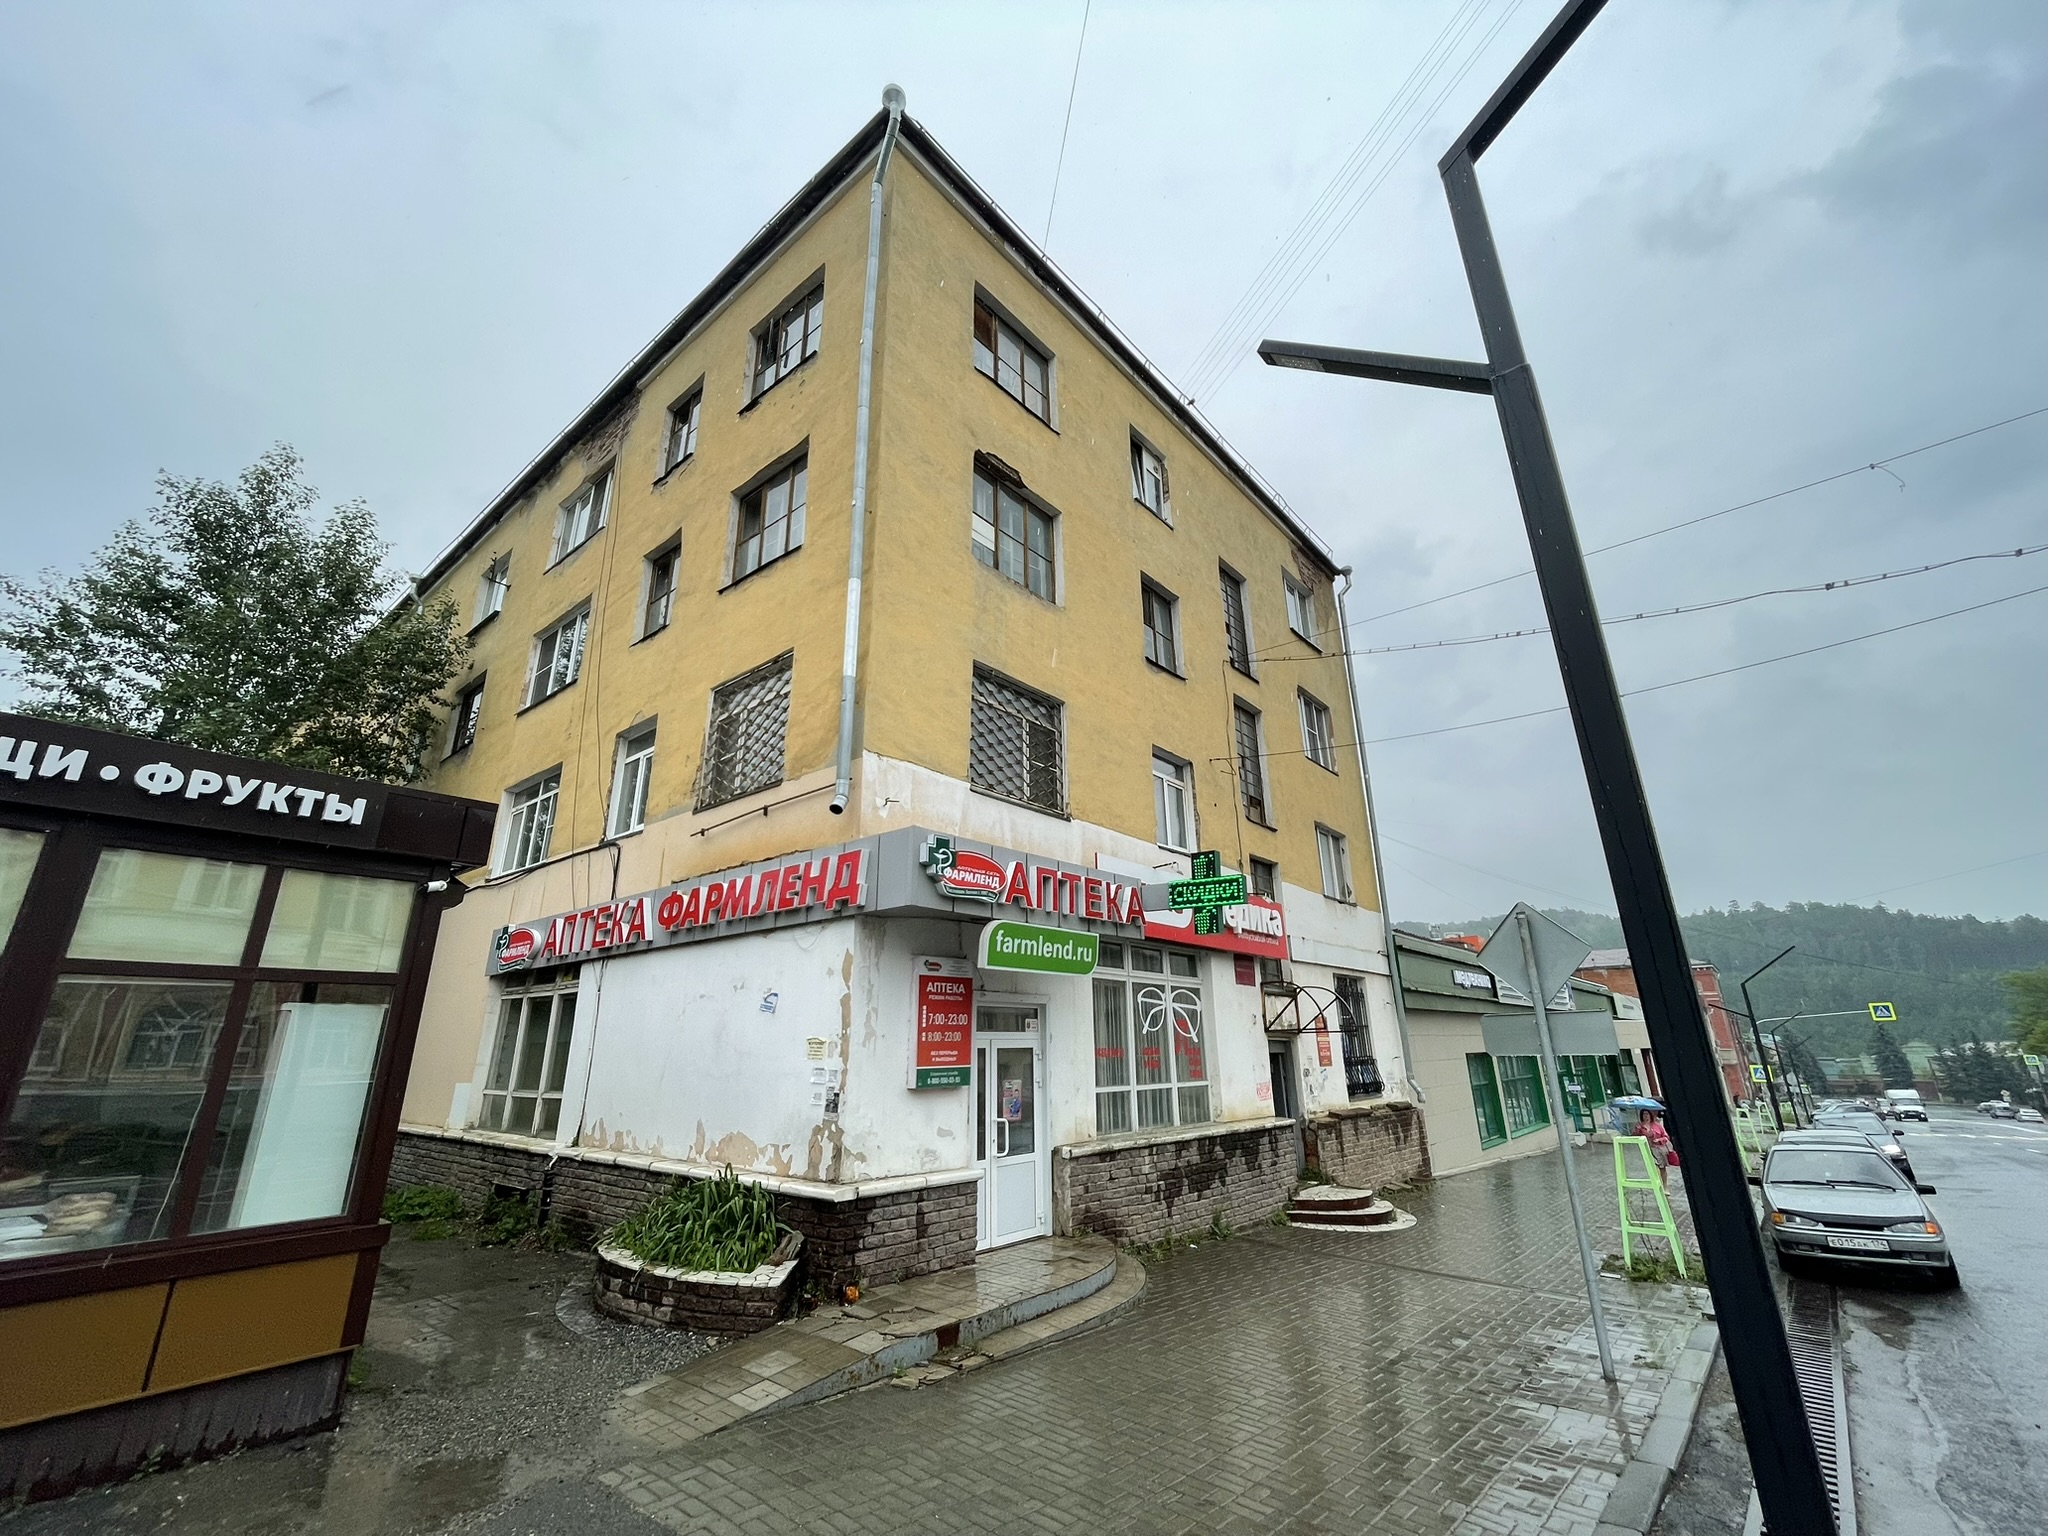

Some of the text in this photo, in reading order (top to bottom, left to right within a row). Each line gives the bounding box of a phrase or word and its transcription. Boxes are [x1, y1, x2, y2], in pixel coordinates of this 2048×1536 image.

[134, 762, 367, 825] ФРУКТЫ
[943, 867, 1000, 888] ФАРМЛЕНД
[540, 848, 866, 958] АПТЕКА ФАРМЛЕНД
[1004, 860, 1147, 927] АПТЕКА
[1173, 881, 1239, 902] СКИДКИ
[1222, 904, 1284, 937] едика
[995, 929, 1093, 963] farmlend.ru
[926, 981, 965, 994] АПТЕКА
[928, 1013, 968, 1025] 7:00-23:00
[927, 1031, 962, 1042] 8:00-23:00
